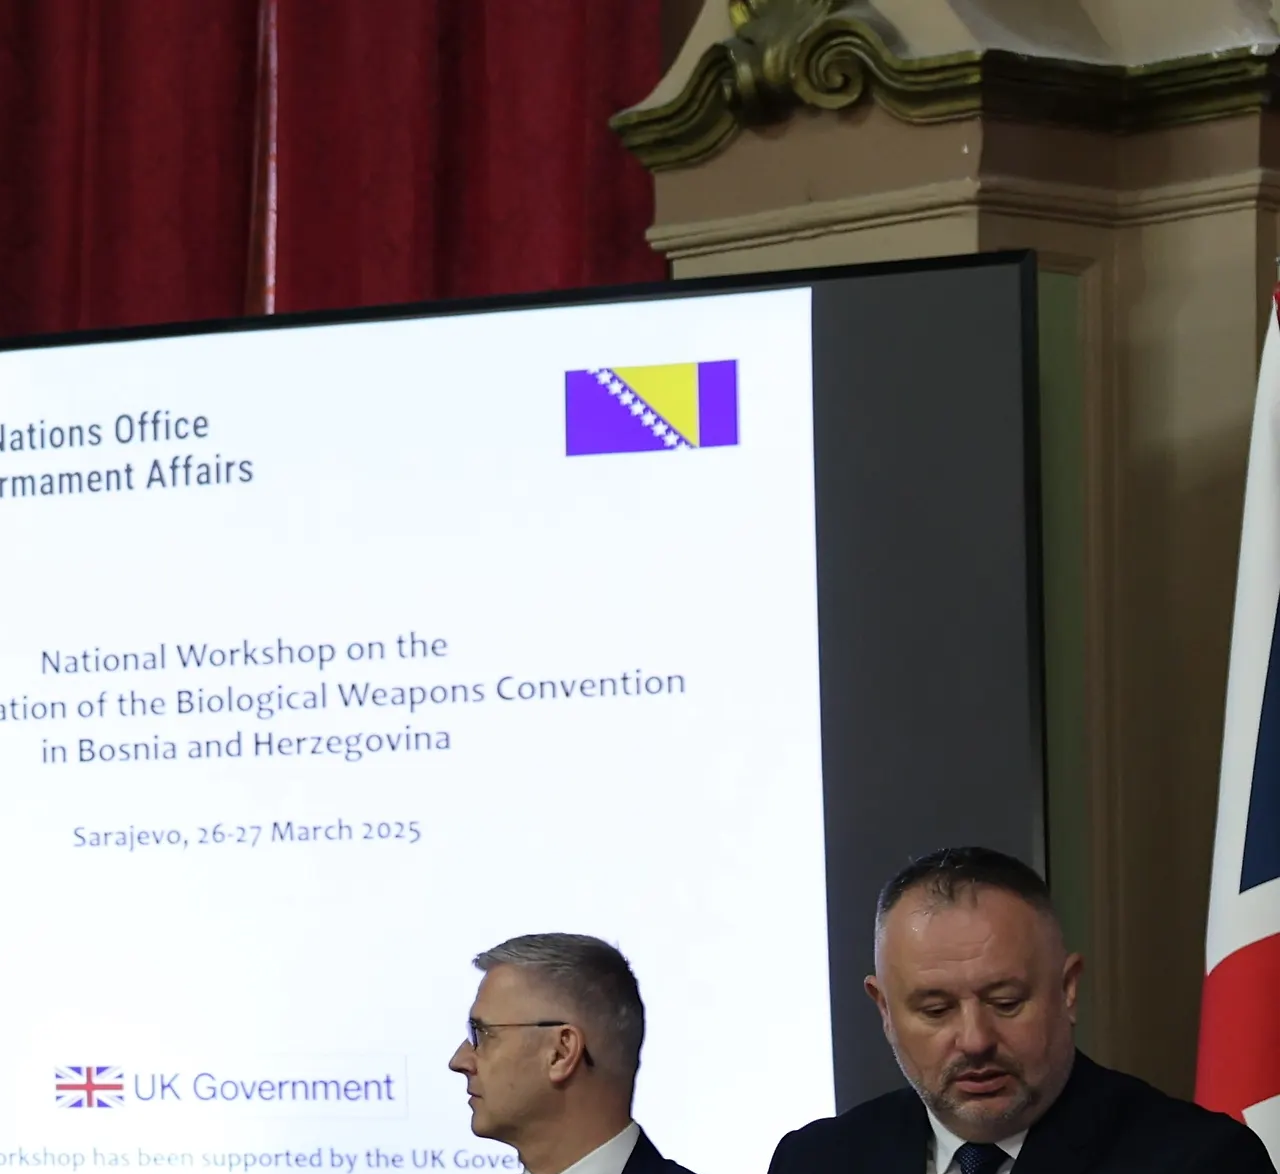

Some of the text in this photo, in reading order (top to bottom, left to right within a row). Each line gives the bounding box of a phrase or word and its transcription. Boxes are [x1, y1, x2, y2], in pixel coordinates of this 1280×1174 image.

[115, 410, 209, 444] Office
[146, 453, 253, 489] Affairs
[42, 631, 448, 674] National Workshop on the
[77, 690, 110, 718] of
[117, 690, 165, 718] the
[177, 682, 326, 720] Biological
[338, 682, 485, 713] Weapons
[496, 669, 685, 701] Convention
[42, 725, 450, 763] in Bosnia and Herzegovina
[74, 818, 421, 851] Sarajevo, 26-27 March 2025
[135, 1072, 395, 1102] UK Government
[93, 1147, 131, 1167] has
[138, 1147, 194, 1167] been
[202, 1148, 322, 1172] supported
[330, 1148, 358, 1173] by
[366, 1148, 404, 1168] the
[412, 1149, 445, 1168] UK
